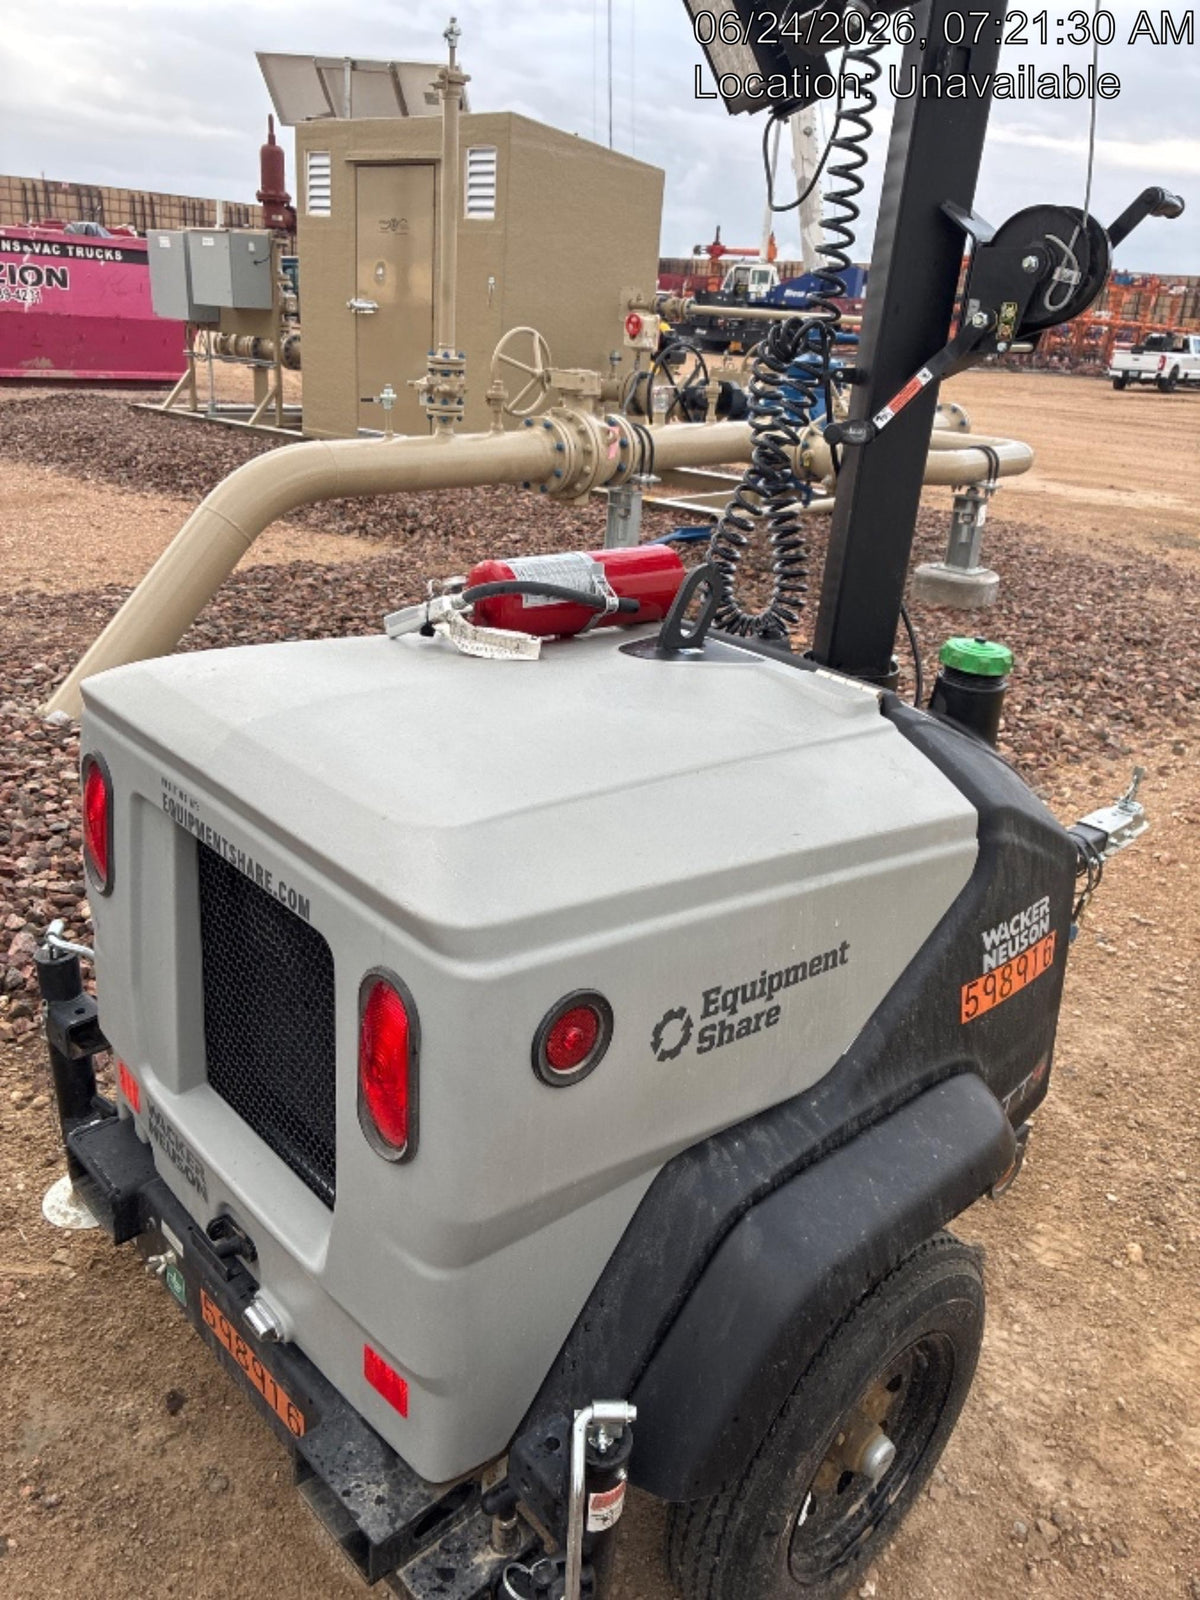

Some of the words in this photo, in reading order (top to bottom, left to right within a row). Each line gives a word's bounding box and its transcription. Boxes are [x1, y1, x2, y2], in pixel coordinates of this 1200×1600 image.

[0, 263, 70, 290] ION
[32, 242, 62, 256] VAC
[66, 246, 123, 262] TRUCKS
[162, 792, 310, 921] EQUIPMENTSHARE.COM
[981, 896, 1050, 951] WACKER
[982, 914, 1050, 975] NEUSON
[700, 940, 850, 1020] Equipment
[963, 937, 1056, 1018] 598916
[697, 1004, 781, 1055] Share
[203, 1294, 300, 1438] 598916
